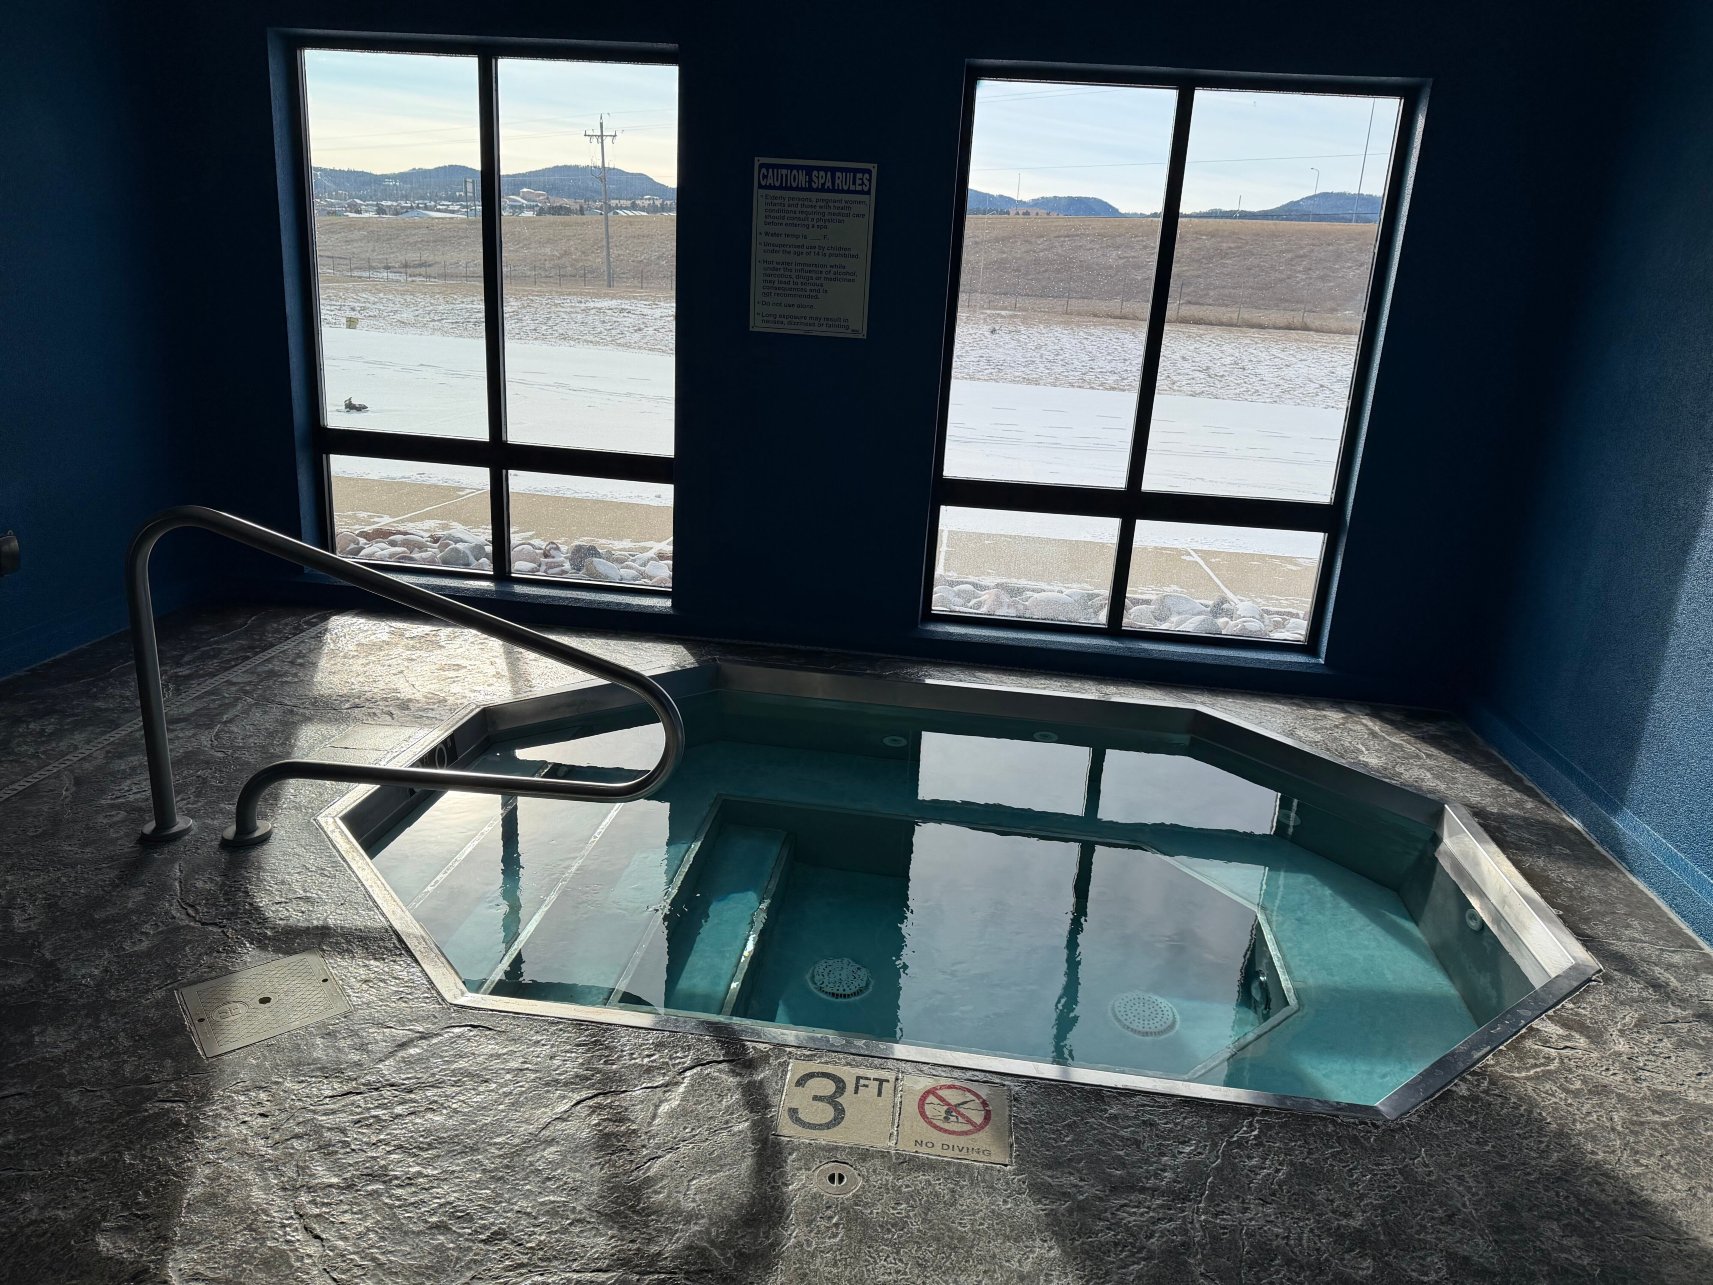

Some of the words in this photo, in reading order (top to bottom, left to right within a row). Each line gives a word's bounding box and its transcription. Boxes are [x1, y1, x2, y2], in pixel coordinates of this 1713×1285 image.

[760, 168, 808, 188] CAUTION:
[812, 170, 832, 189] SPA
[835, 172, 870, 191] RULES
[787, 1071, 847, 1131] 3
[853, 1076, 890, 1097] FT
[914, 1139, 935, 1149] NO
[941, 1142, 992, 1157] DIVING
